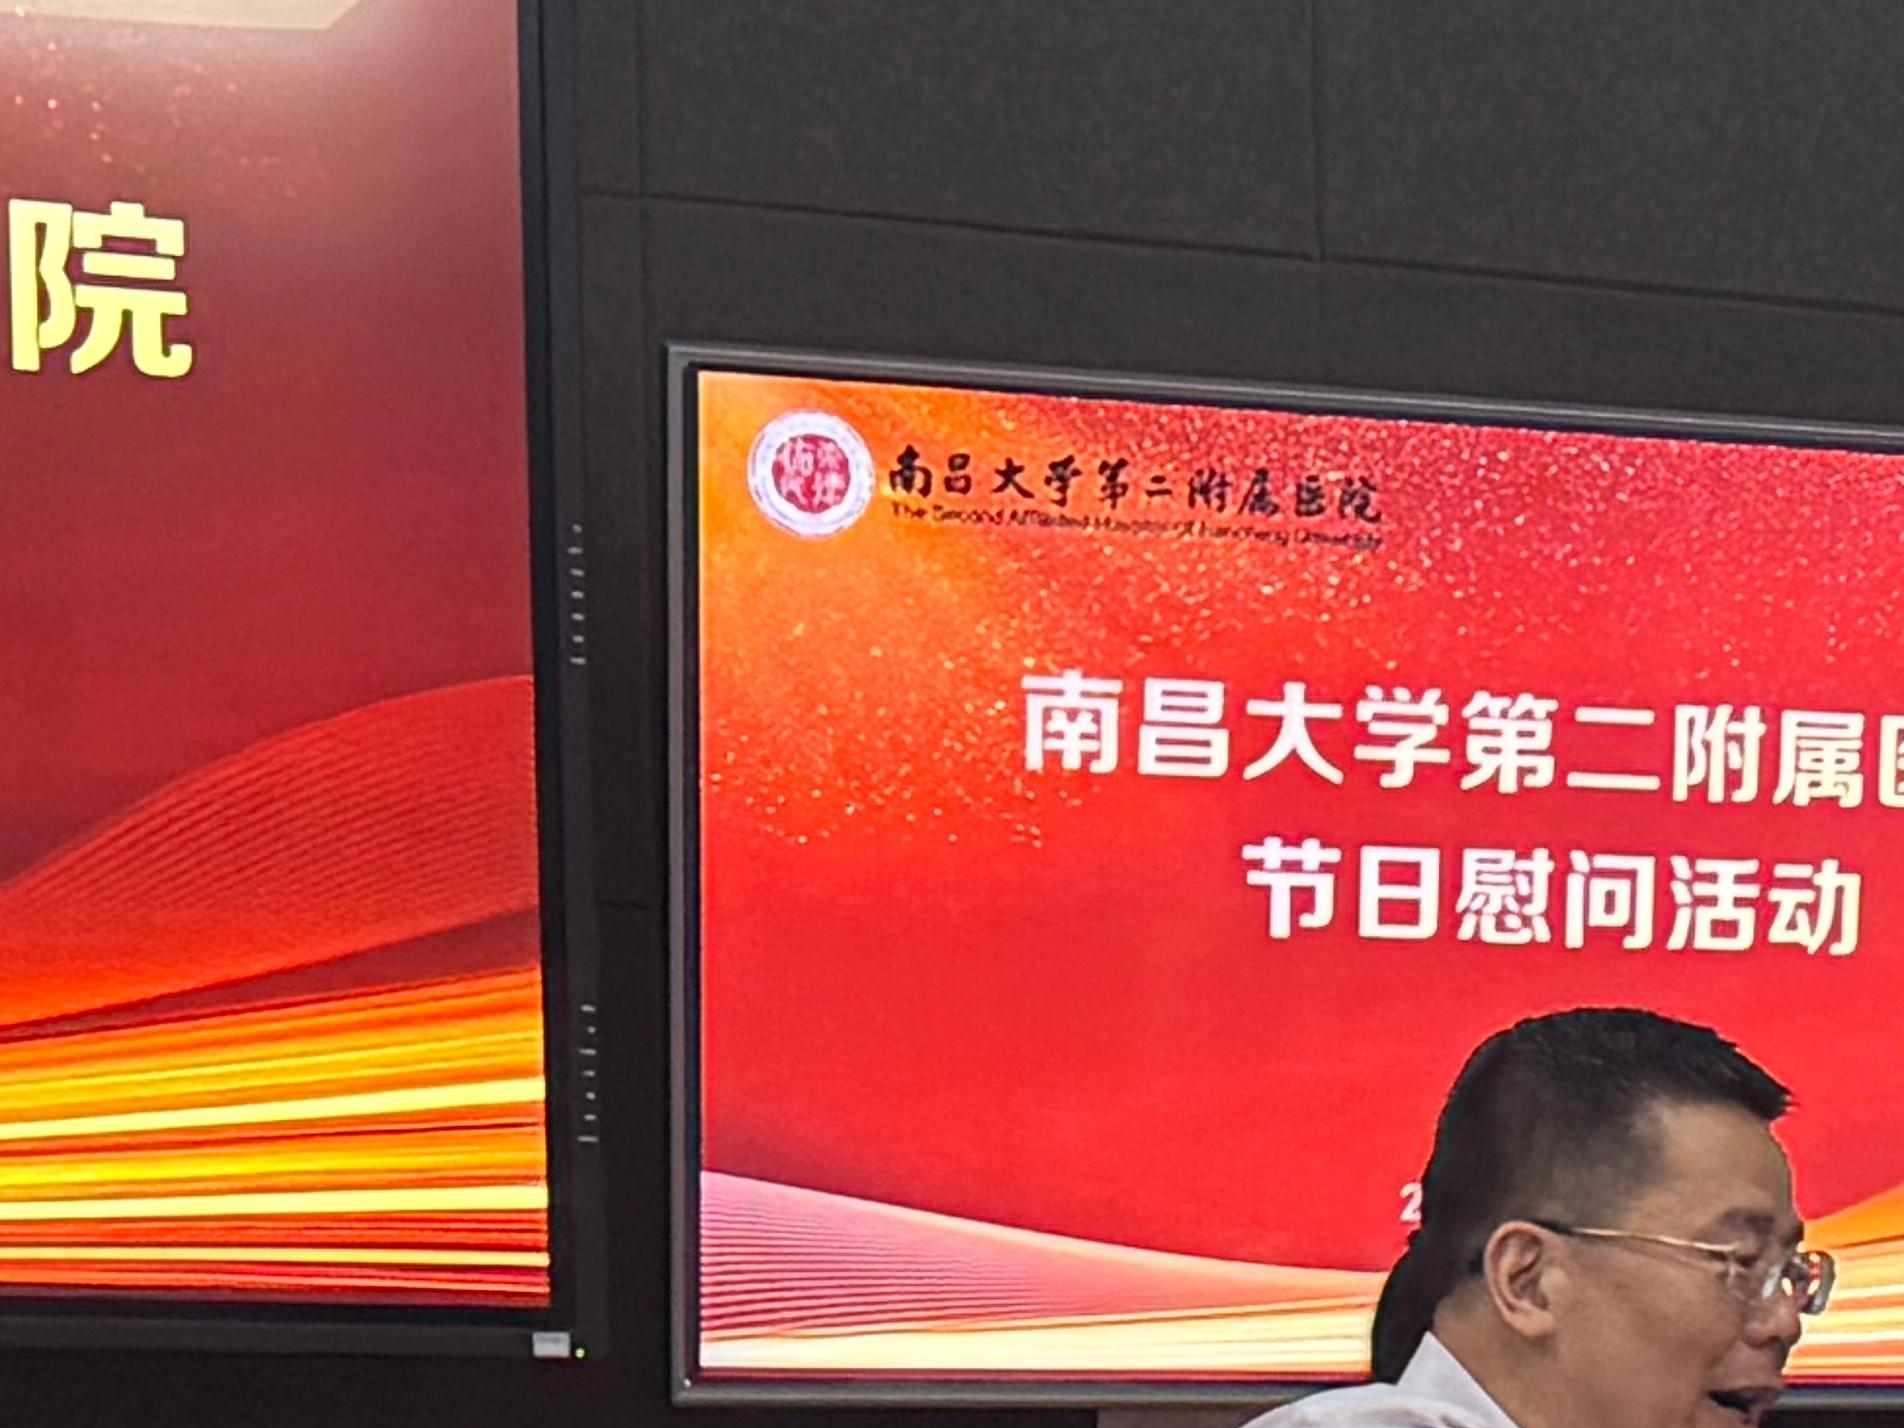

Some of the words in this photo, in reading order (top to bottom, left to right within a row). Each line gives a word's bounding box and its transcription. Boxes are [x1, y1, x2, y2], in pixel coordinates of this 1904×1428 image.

[8, 198, 193, 378] 院
[890, 444, 1382, 524] 南昌大学第二附属医院
[1242, 836, 1862, 956] 节日慰问活动
